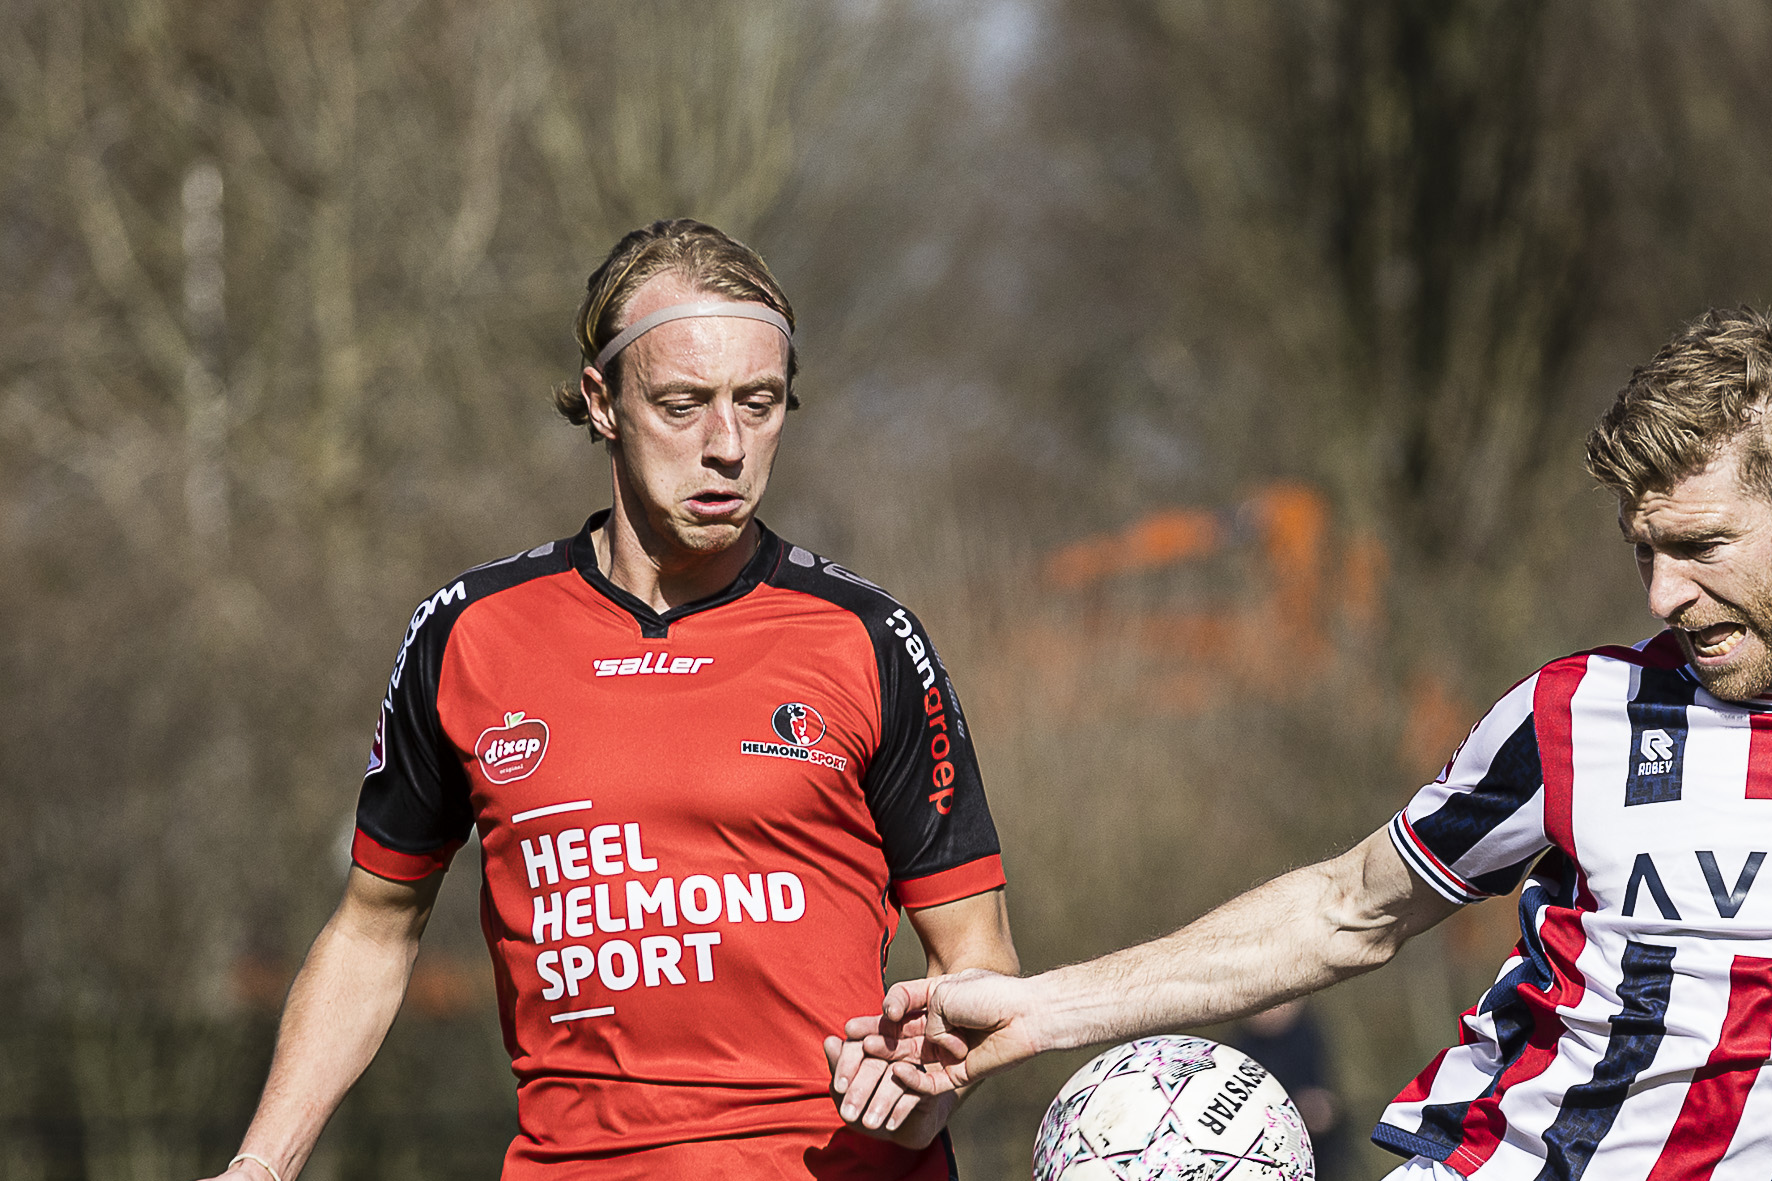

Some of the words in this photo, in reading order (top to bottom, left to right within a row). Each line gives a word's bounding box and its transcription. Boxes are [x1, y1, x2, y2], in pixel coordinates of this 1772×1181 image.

[484, 738, 541, 764] dixap
[742, 743, 809, 759] HELMOND
[810, 752, 846, 769] SPORT
[520, 822, 659, 889] HEEL
[532, 871, 807, 945] HELMOND
[535, 931, 723, 1001] SPORT
